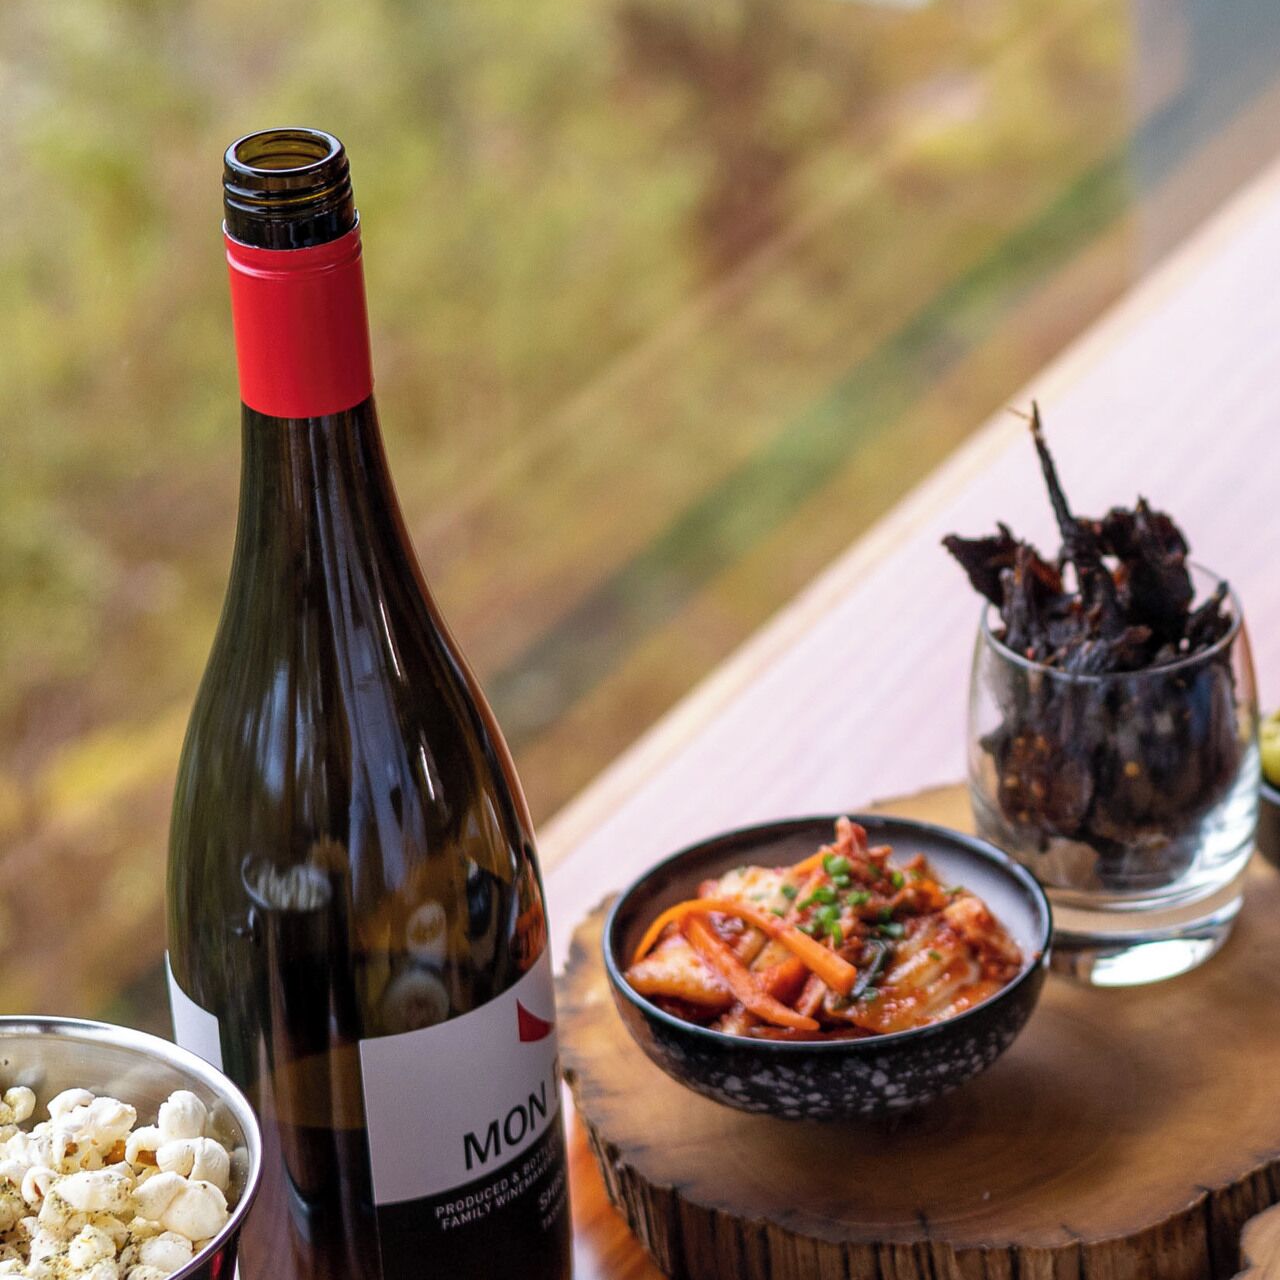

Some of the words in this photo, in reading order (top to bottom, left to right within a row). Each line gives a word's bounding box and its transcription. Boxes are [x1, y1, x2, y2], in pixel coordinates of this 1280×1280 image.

[463, 1080, 547, 1171] MON
[435, 1177, 509, 1219] PRODUCED
[441, 1201, 492, 1231] FAMILY
